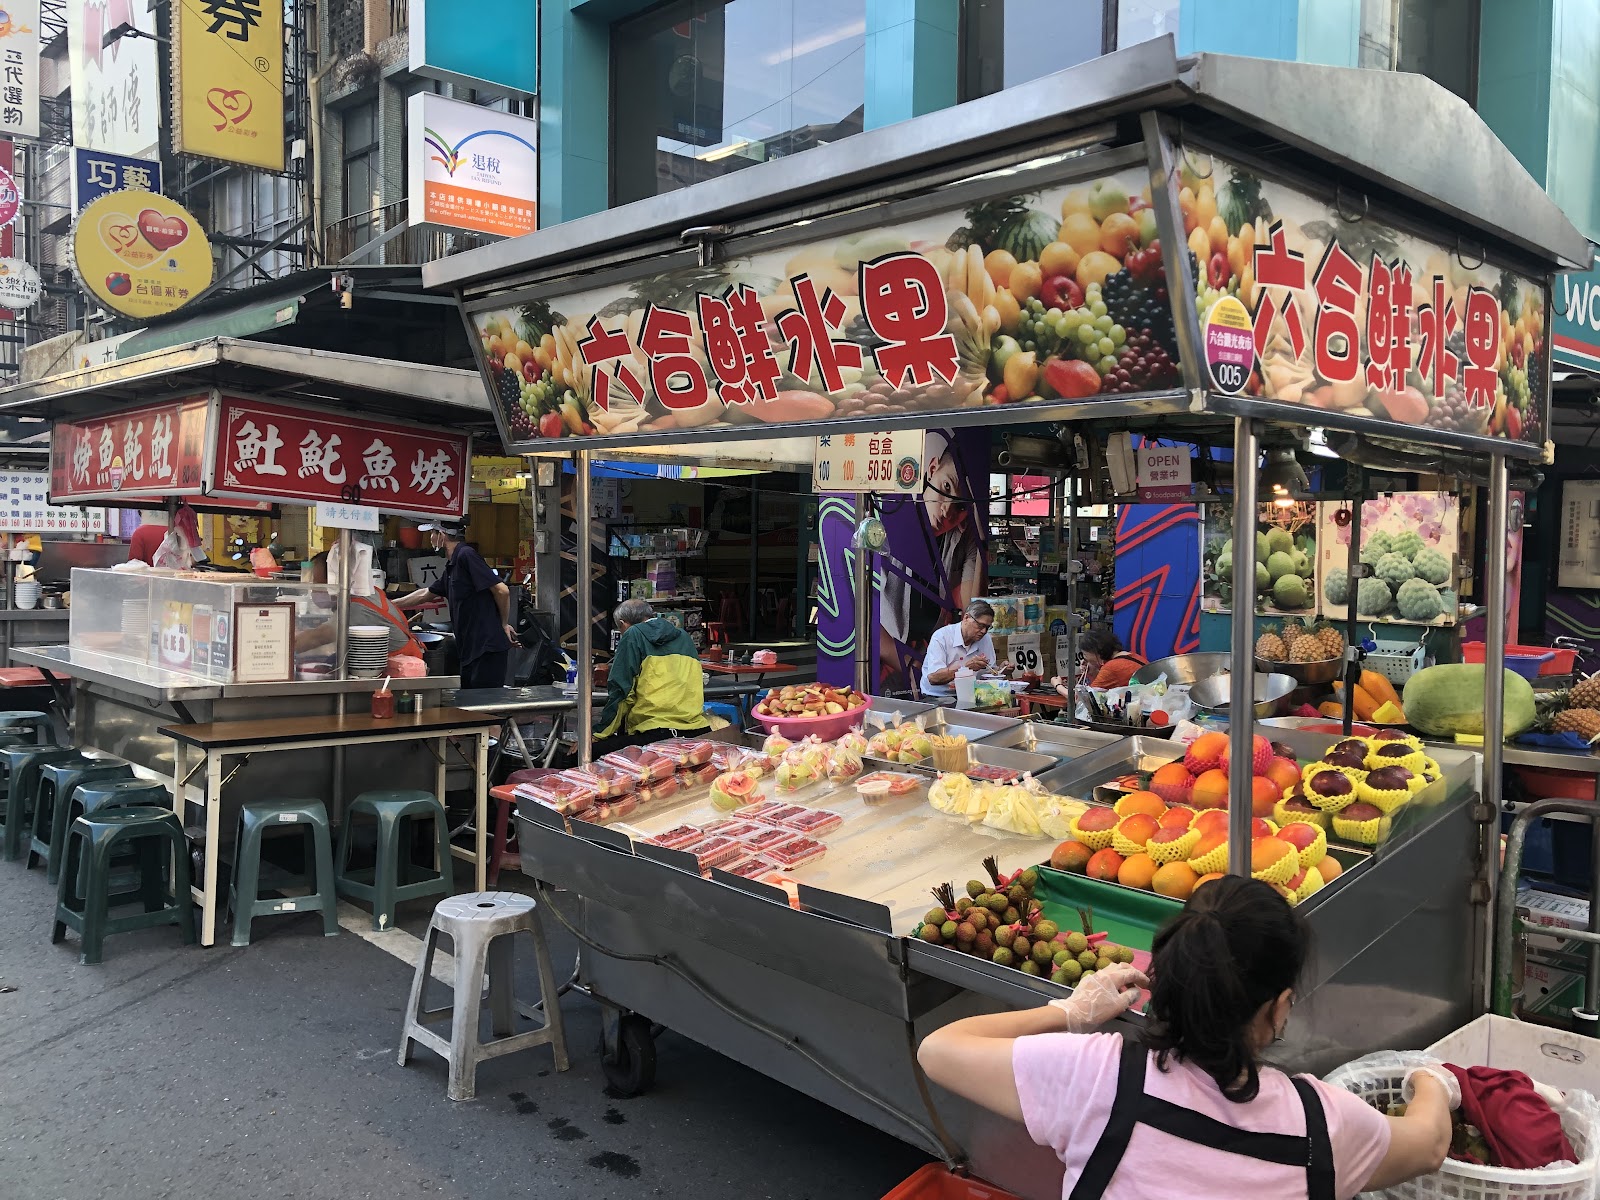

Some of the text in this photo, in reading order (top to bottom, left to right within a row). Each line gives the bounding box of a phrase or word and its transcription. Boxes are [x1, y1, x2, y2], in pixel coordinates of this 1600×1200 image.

[439, 209, 452, 217] offer
[497, 219, 514, 228] refund
[1252, 218, 1502, 414] 六合鮮水果
[578, 251, 961, 412] 六合鮮水果
[1219, 363, 1242, 386] 005
[843, 459, 855, 480] 100
[867, 459, 879, 480] 50
[880, 459, 892, 480] 50
[1147, 455, 1180, 467] OPEN
[1149, 470, 1179, 482] 營業中
[1152, 489, 1187, 500] foodpanda
[325, 506, 374, 523] 請先付款
[47, 520, 55, 528] 90
[58, 520, 67, 528] 80
[70, 520, 78, 528] 60
[93, 520, 101, 528] 60
[1015, 649, 1038, 671] 99
